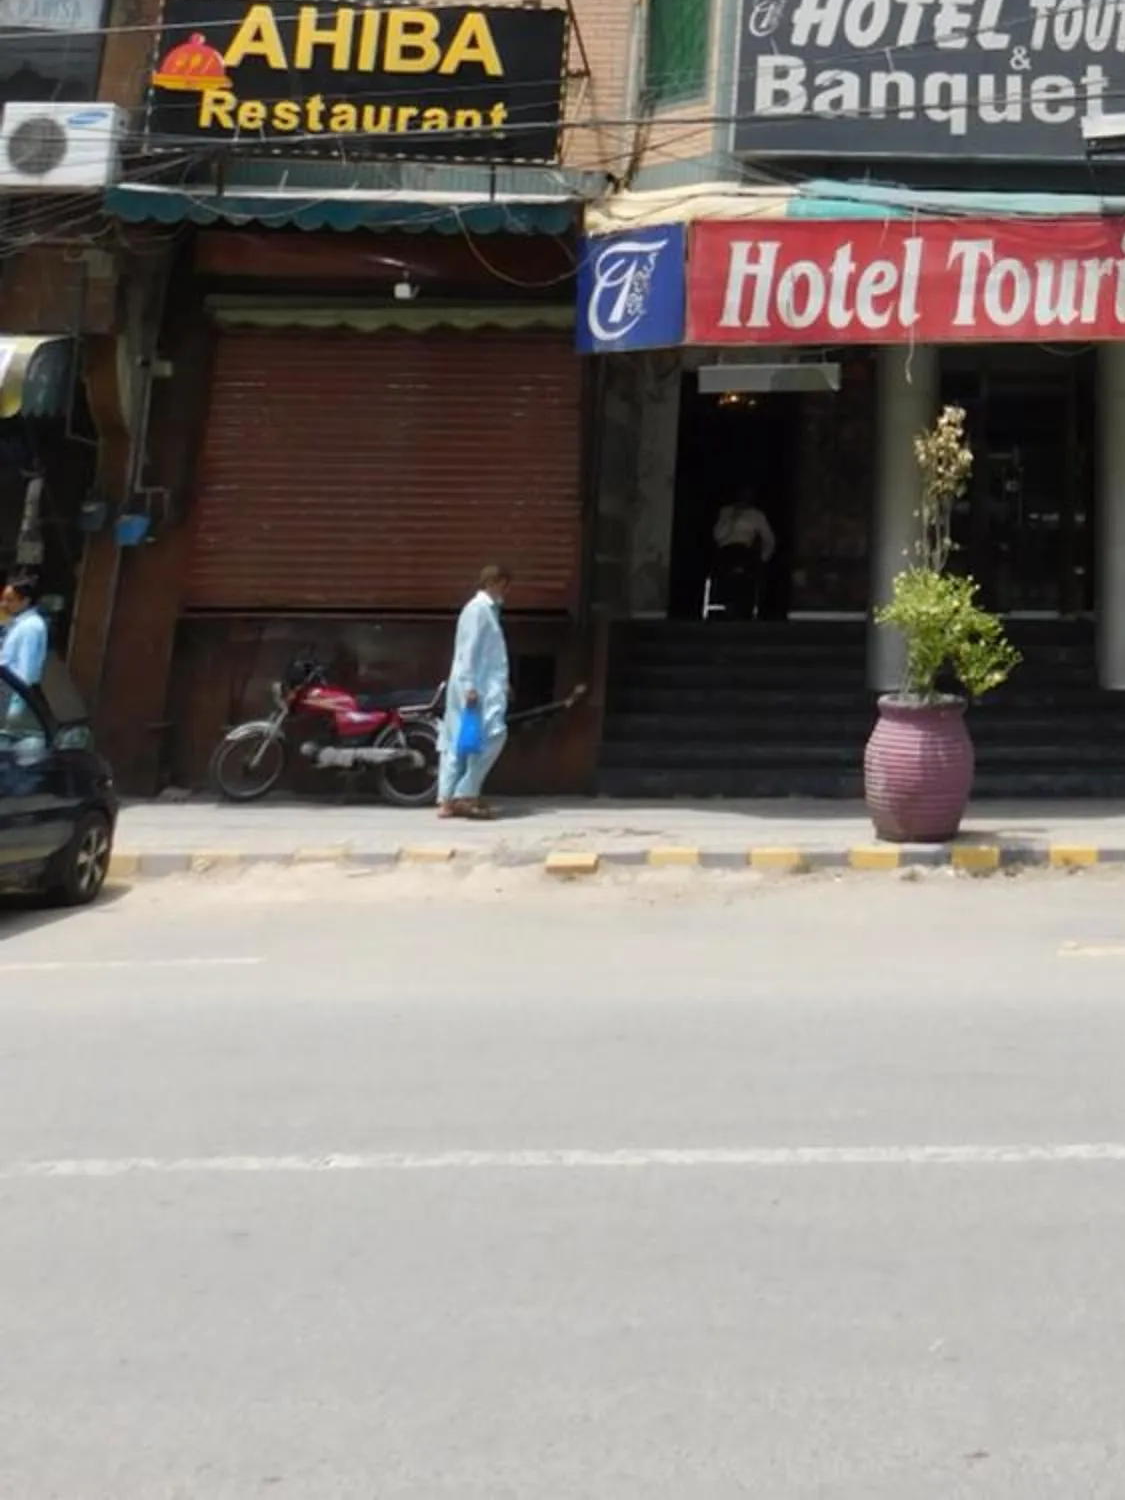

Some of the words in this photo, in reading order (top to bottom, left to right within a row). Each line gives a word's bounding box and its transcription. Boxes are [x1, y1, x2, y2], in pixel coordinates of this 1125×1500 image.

[225, 5, 505, 77] AHIBA
[1010, 45, 1032, 71] &
[200, 88, 508, 139] Restaurant
[755, 54, 1109, 136] Banquet
[718, 237, 924, 328] Hotel
